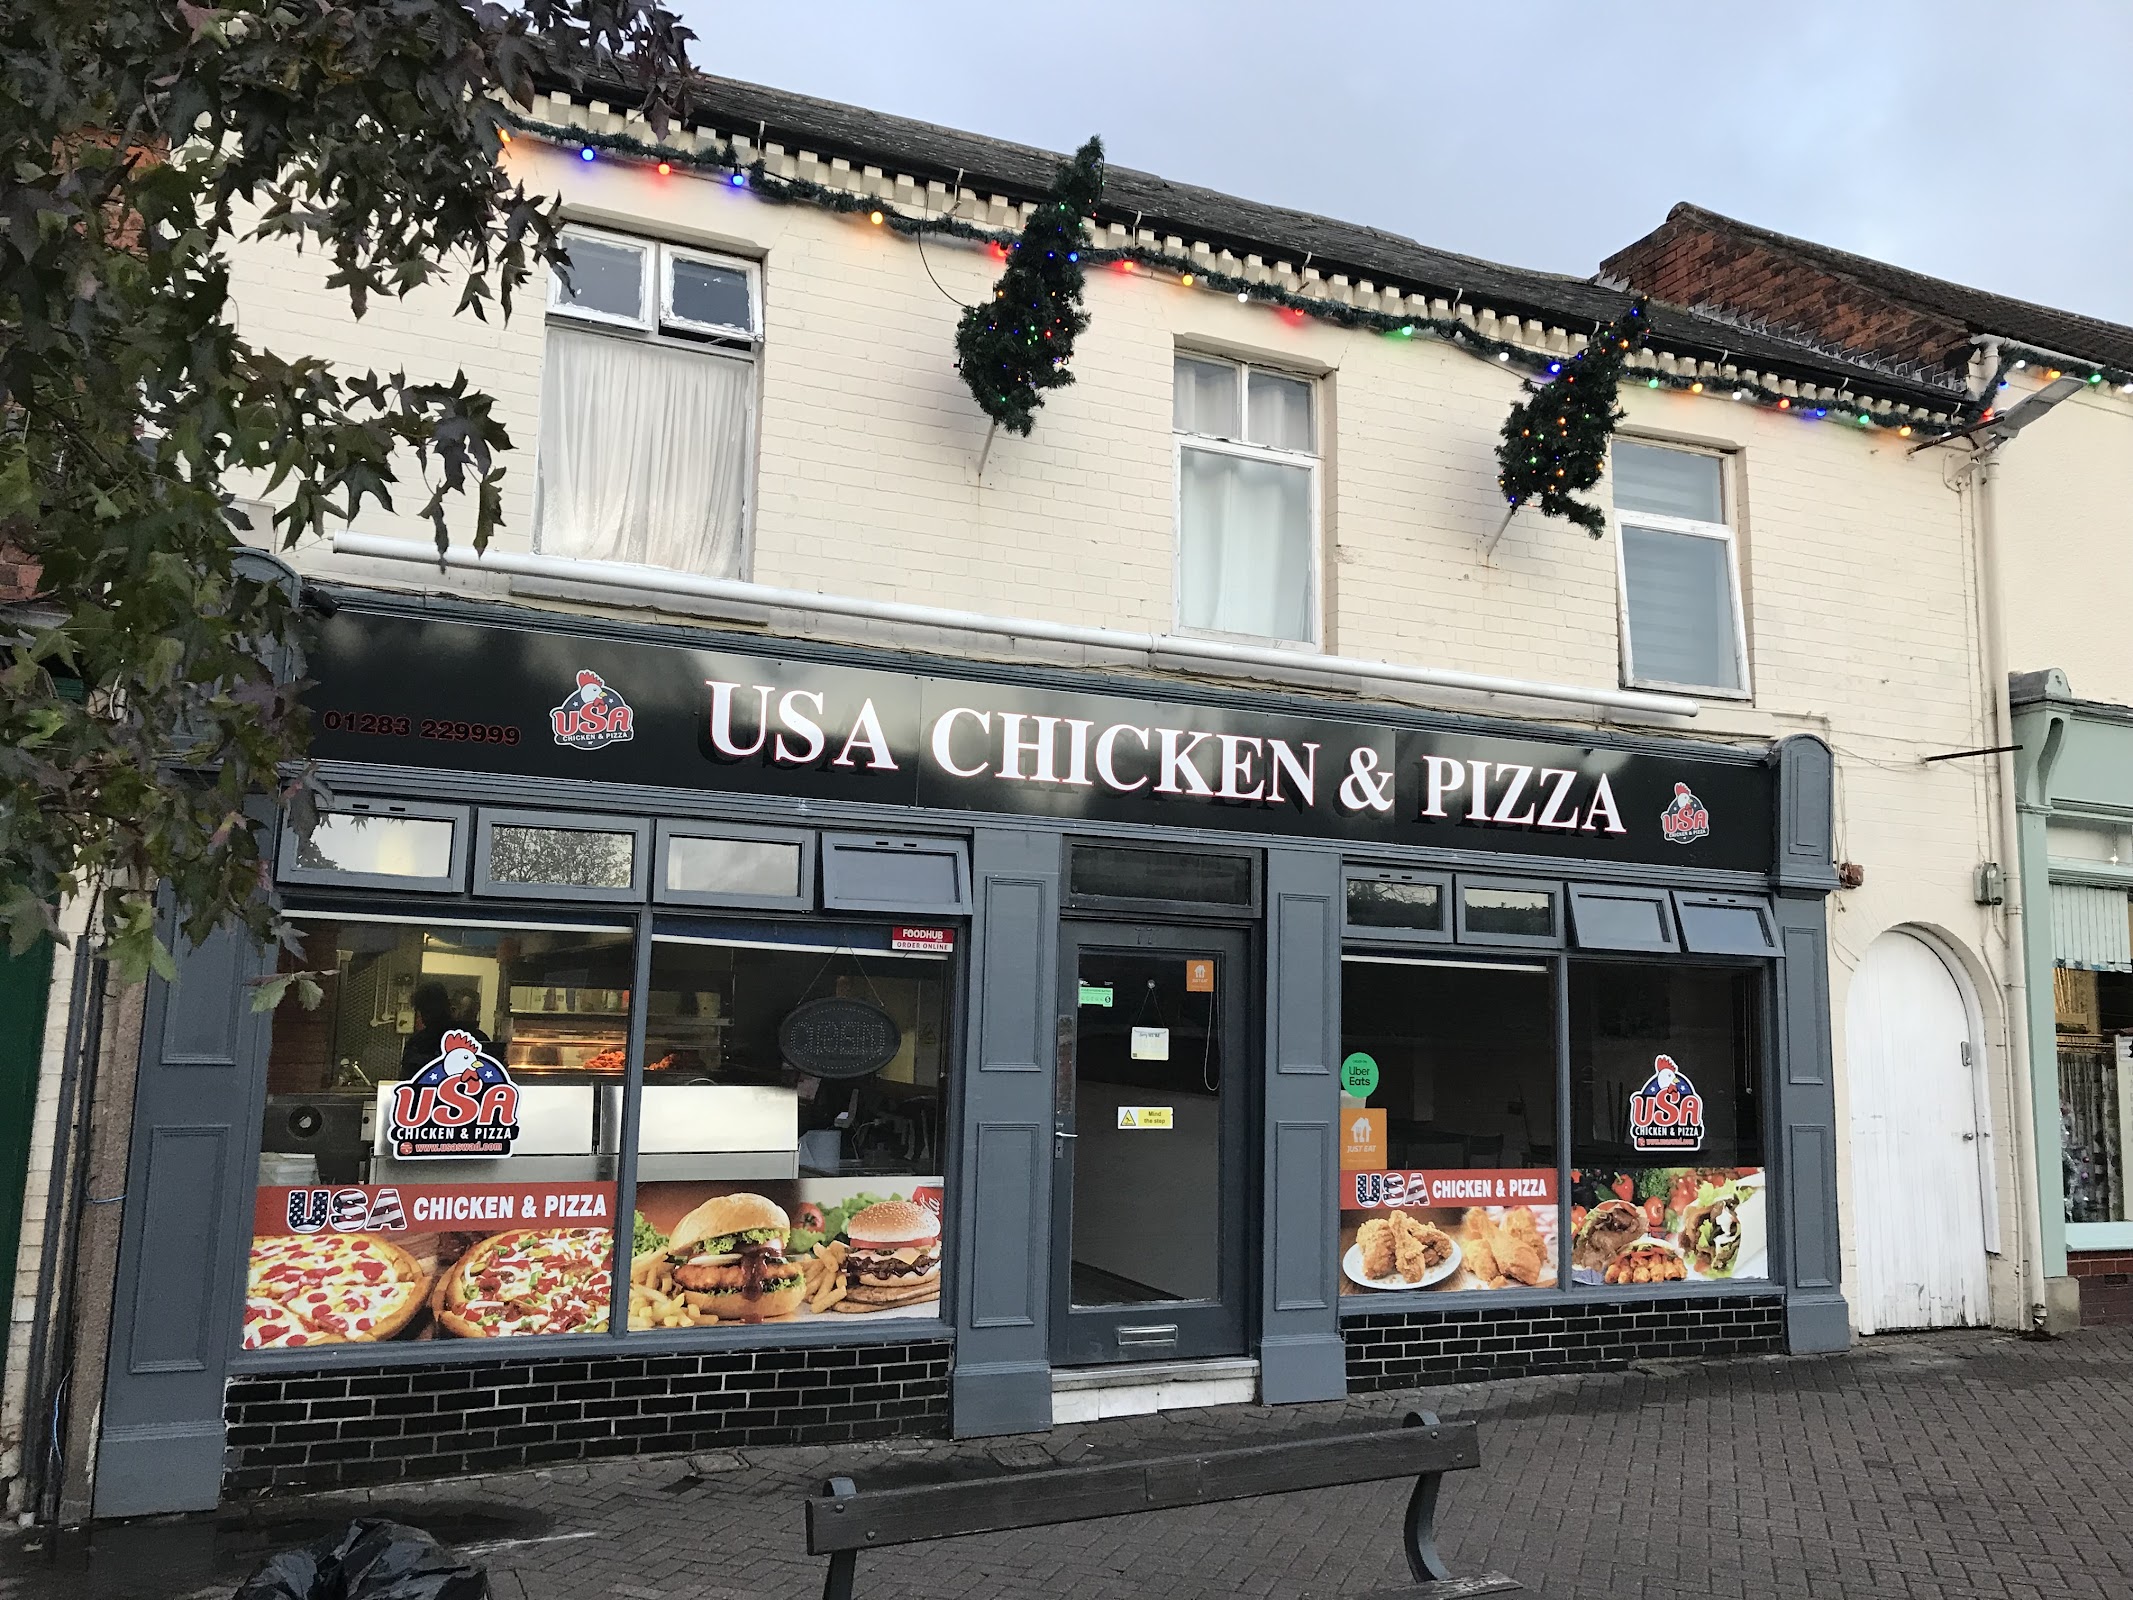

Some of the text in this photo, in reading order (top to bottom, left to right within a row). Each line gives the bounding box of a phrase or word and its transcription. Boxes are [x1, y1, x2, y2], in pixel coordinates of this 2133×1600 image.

[322, 710, 522, 746] 01283 229999
[553, 702, 631, 736] USA
[562, 734, 596, 742] CHICKEN
[705, 680, 1628, 834] USA CHICKEN & PIZZA
[1663, 807, 1707, 833] USA
[902, 928, 944, 939] FOODHUB
[897, 941, 948, 951] ORDER ONLINE
[1348, 1066, 1370, 1076] Uber
[1349, 1077, 1371, 1086] Eats
[394, 1073, 518, 1127] USA
[1633, 1087, 1700, 1127] USA
[396, 1127, 512, 1140] CHICKEN & PIZZA
[1635, 1127, 1699, 1136] CHICKEN & PIZZA
[1346, 1145, 1363, 1153] JUST
[1355, 1172, 1548, 1208] USA CHICKEN & PIZZA
[286, 1188, 607, 1234] USA CHICKEN & PIZZA
